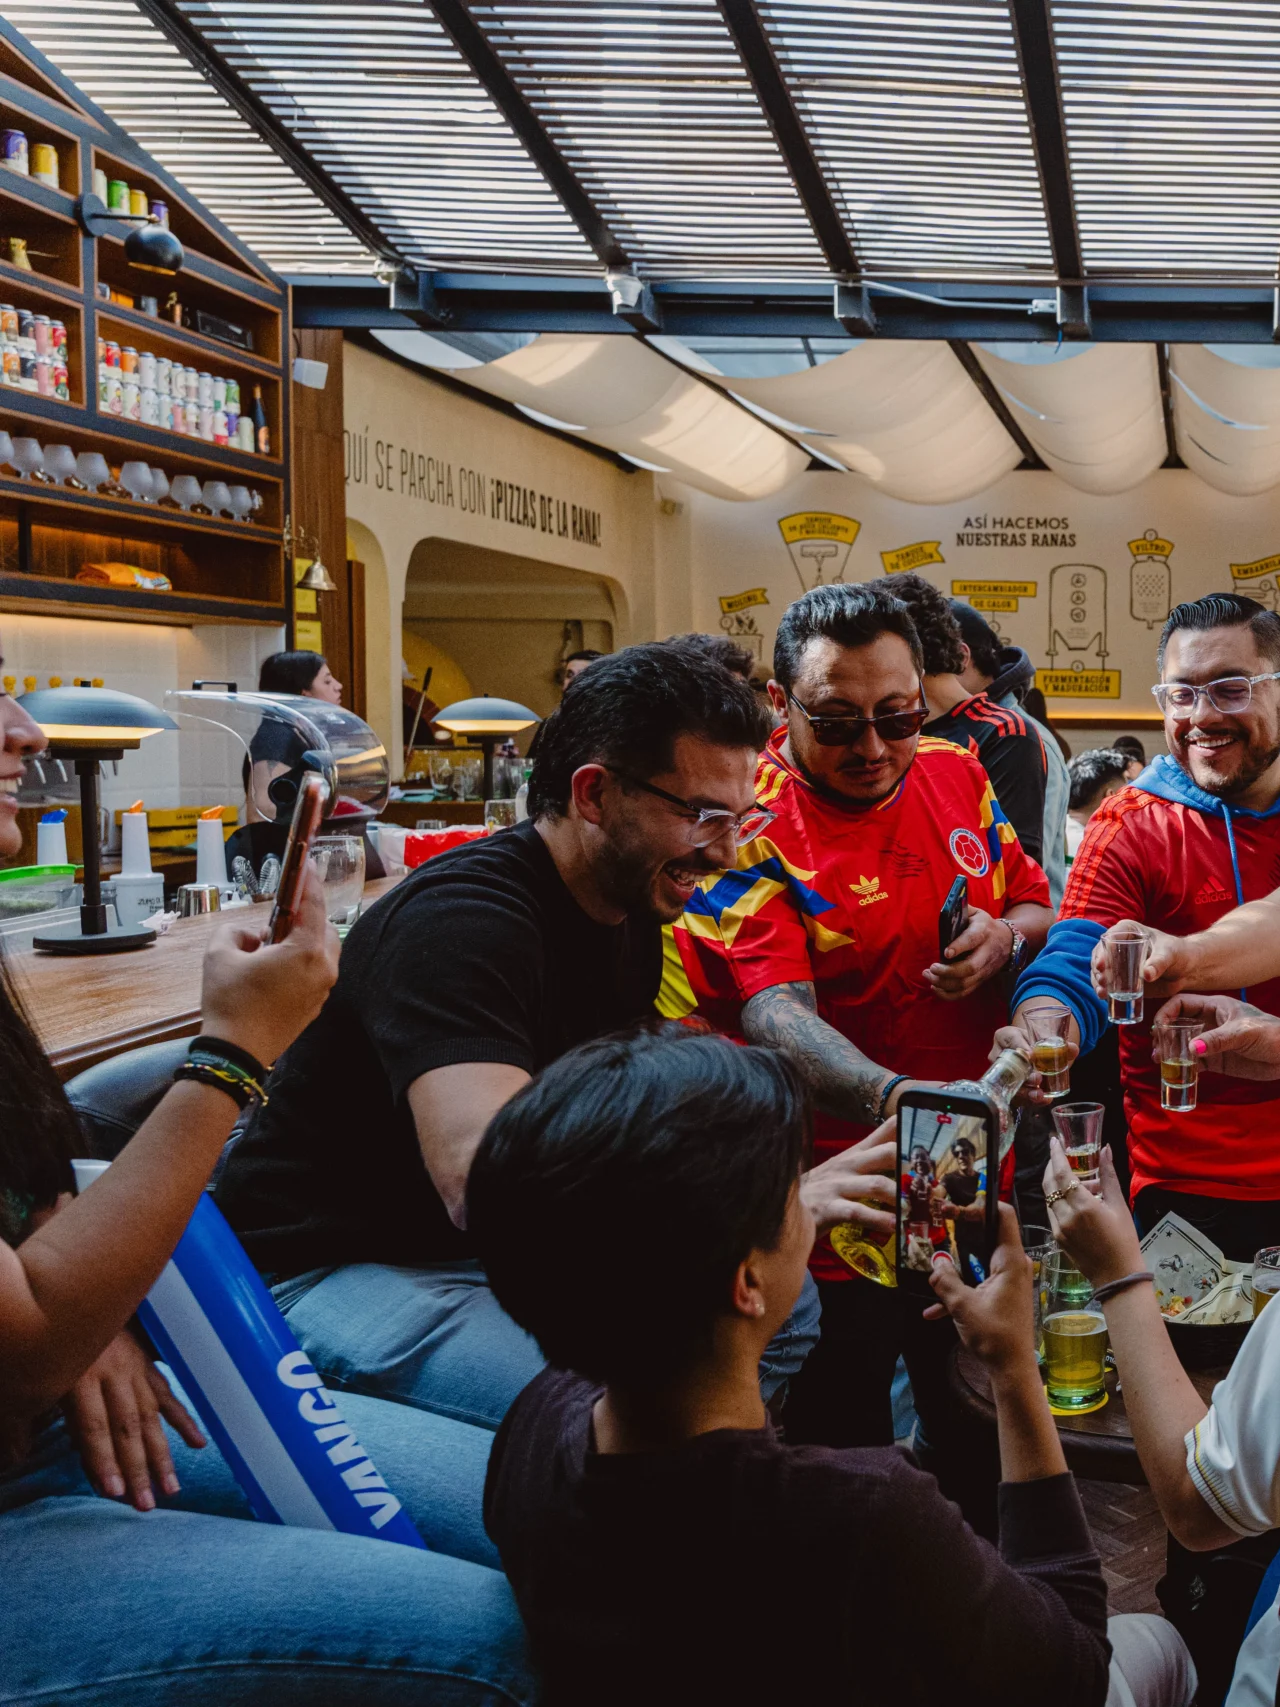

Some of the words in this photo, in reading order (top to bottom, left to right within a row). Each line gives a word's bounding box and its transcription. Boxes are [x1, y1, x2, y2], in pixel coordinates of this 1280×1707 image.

[343, 425, 369, 486] QUÍ
[375, 440, 394, 491] SE
[400, 448, 455, 508] PARCHA
[459, 467, 486, 517] CON
[491, 478, 536, 529] ¡PIZZAS
[540, 493, 554, 534] DE
[556, 499, 569, 538] LA
[963, 513, 988, 529] ASÍ
[992, 517, 1070, 530] HACEMOS
[956, 532, 1027, 547] NUESTRAS
[1031, 533, 1077, 547] RANAS
[1135, 543, 1166, 553] FILTRO
[959, 584, 1029, 593] INTERCAMBIADOR
[987, 600, 1011, 608] CALOR
[1043, 674, 1111, 683] FERMENTACIÓN
[1052, 684, 1110, 692] MADURACIÓN
[858, 891, 889, 906] adidas
[1194, 891, 1233, 905] adidas
